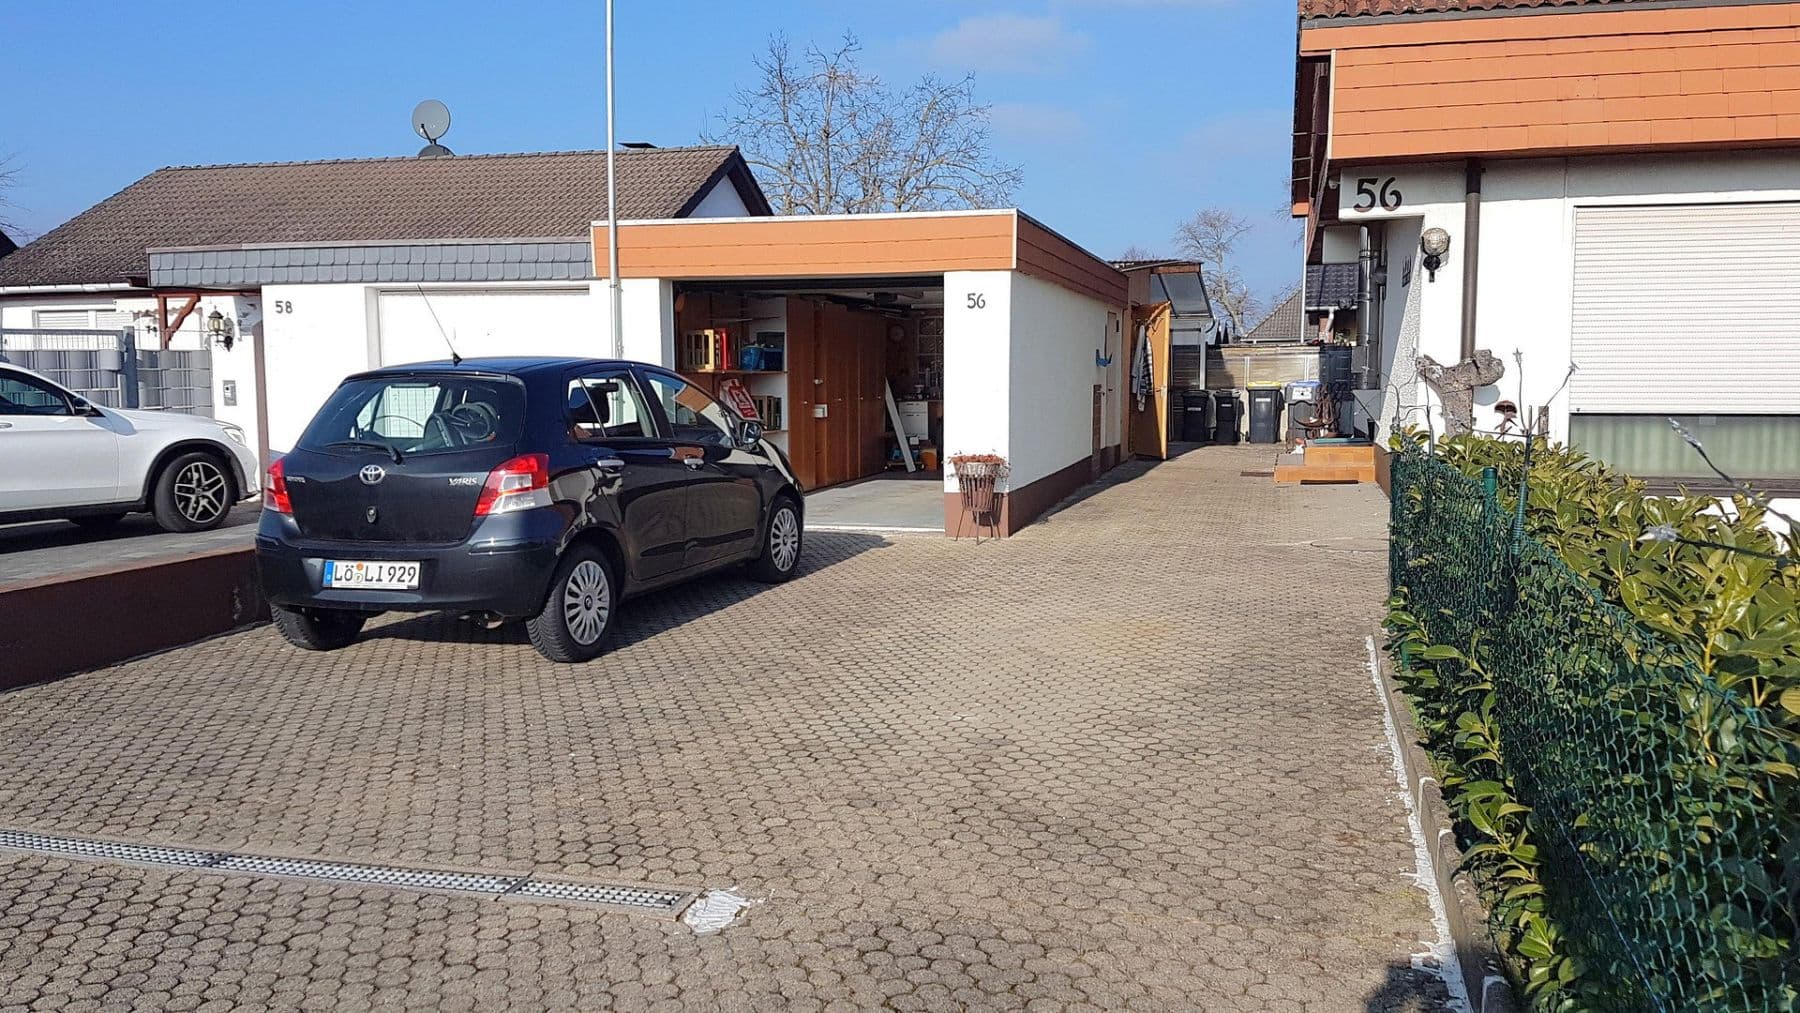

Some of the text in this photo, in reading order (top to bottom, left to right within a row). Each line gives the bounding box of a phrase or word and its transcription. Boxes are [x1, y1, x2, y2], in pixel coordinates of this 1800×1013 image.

[1353, 177, 1402, 212] 56
[275, 300, 293, 314] 58
[967, 292, 986, 309] 56
